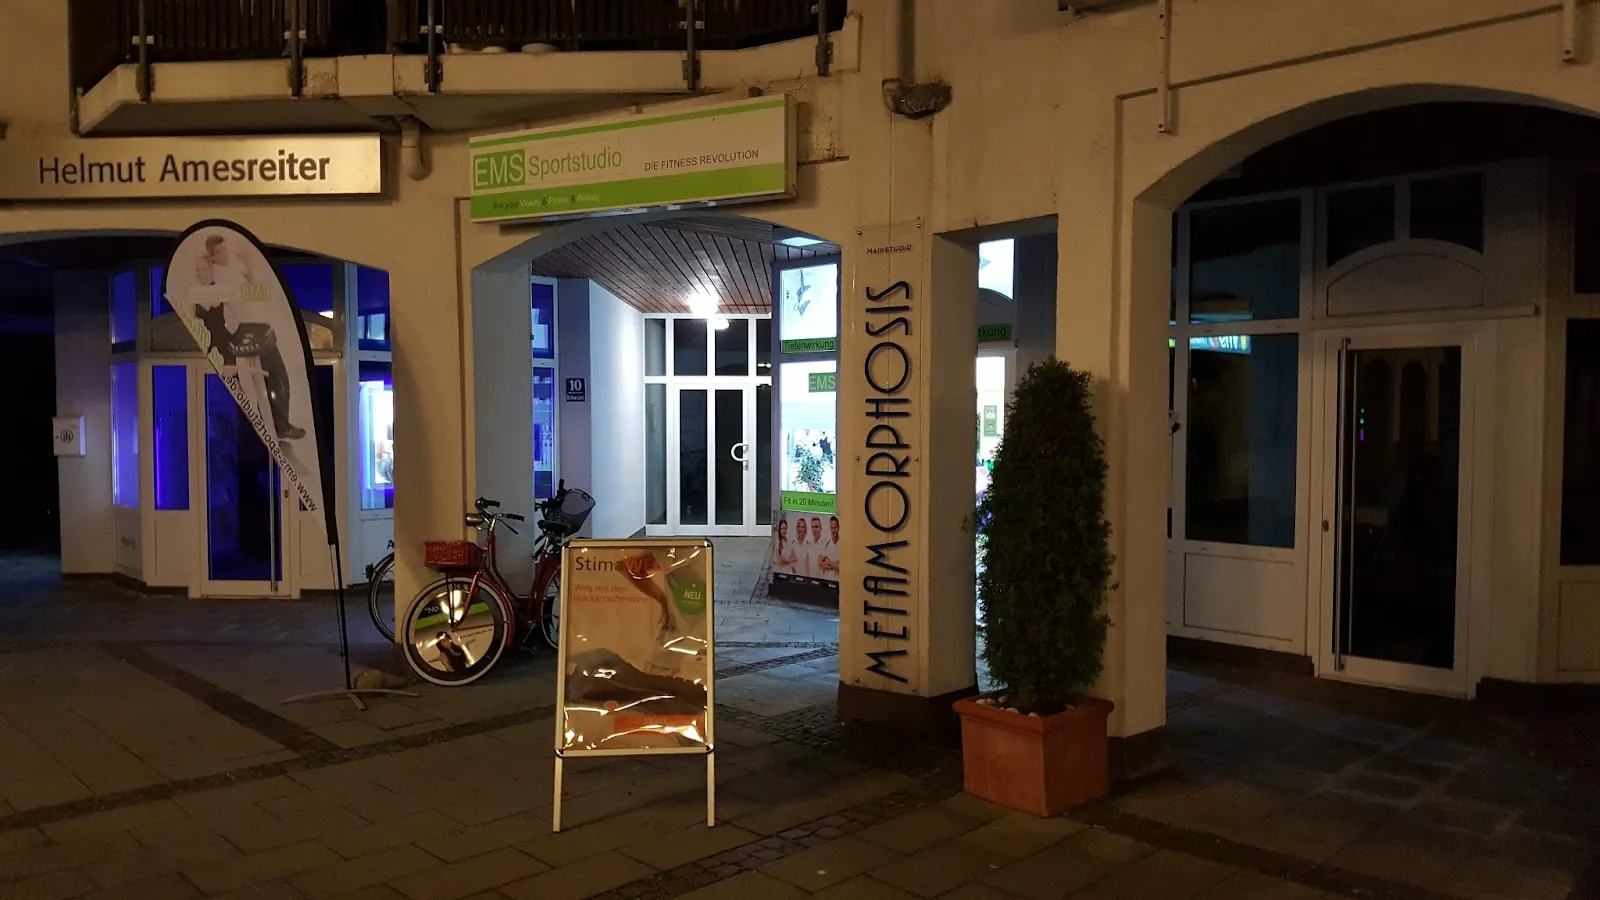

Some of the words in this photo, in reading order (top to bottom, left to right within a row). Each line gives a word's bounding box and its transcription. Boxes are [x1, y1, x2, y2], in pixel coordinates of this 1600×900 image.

[644, 161, 659, 171] DIE
[661, 157, 698, 169] FITNESS
[699, 149, 759, 165] REVOLUTION
[39, 153, 146, 184] Helmut
[159, 149, 330, 183] Amesreiter
[474, 153, 524, 187] EMS
[528, 146, 622, 181] Sportstudio
[493, 202, 504, 210] For
[505, 202, 518, 212] your
[783, 340, 834, 351] Tiefenwirkung
[568, 379, 582, 391] 10
[809, 375, 836, 390] EMS
[863, 280, 912, 684] METAMORPHOSIS
[783, 496, 791, 504] Fit
[792, 497, 798, 505] in
[799, 498, 807, 506] 20
[808, 499, 834, 508] Minuten!
[574, 584, 592, 593] Weg
[594, 583, 608, 592] mit
[611, 583, 627, 592] den
[684, 590, 702, 600] NEU
